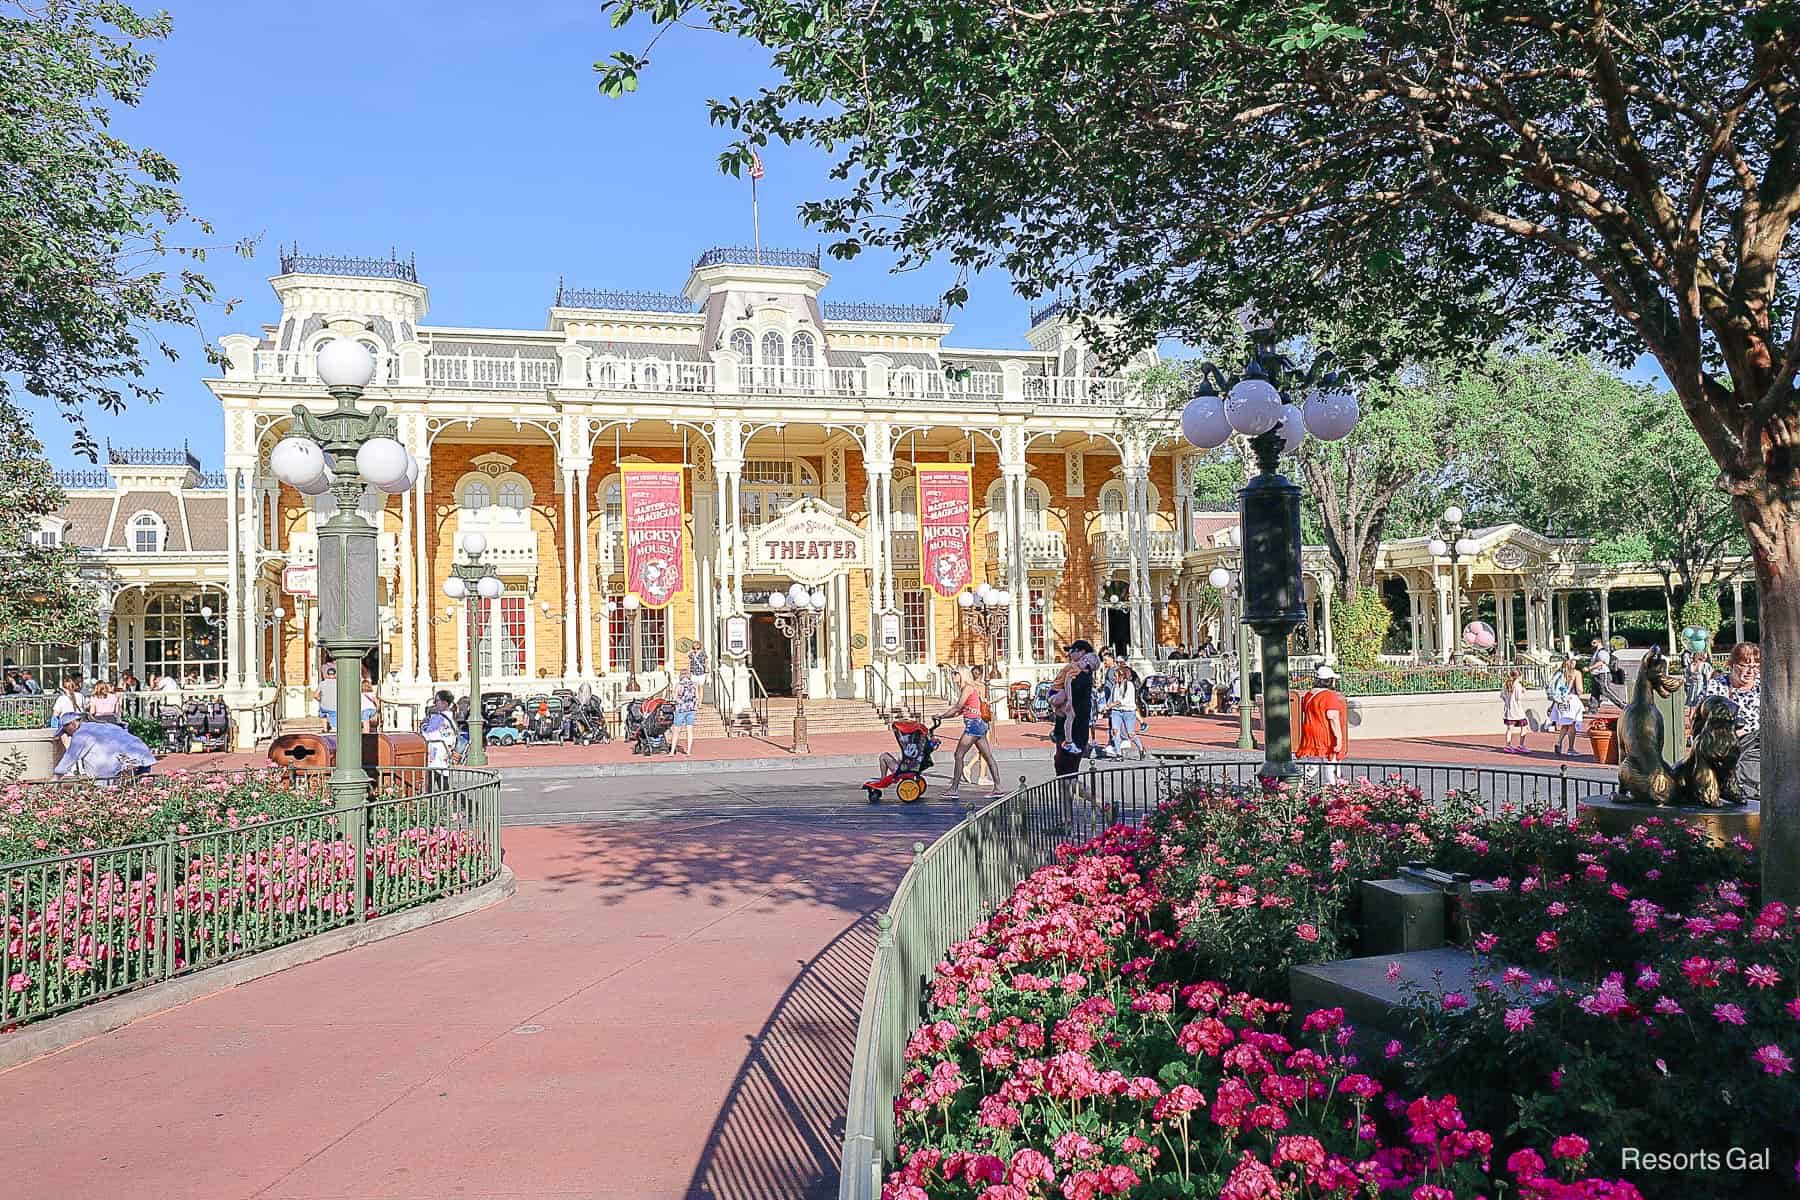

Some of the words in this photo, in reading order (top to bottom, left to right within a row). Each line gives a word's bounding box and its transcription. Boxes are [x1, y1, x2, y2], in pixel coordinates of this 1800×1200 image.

[634, 501, 666, 516] MASTER
[927, 499, 958, 512] MASTER
[930, 503, 969, 519] MAGICIAN
[637, 507, 680, 523] MAGICIAN
[629, 530, 681, 549] MICKEY
[923, 526, 970, 544] MICKEY
[637, 543, 674, 557] MOUSE
[765, 540, 857, 560] THEATER
[930, 539, 963, 552] MOUSE
